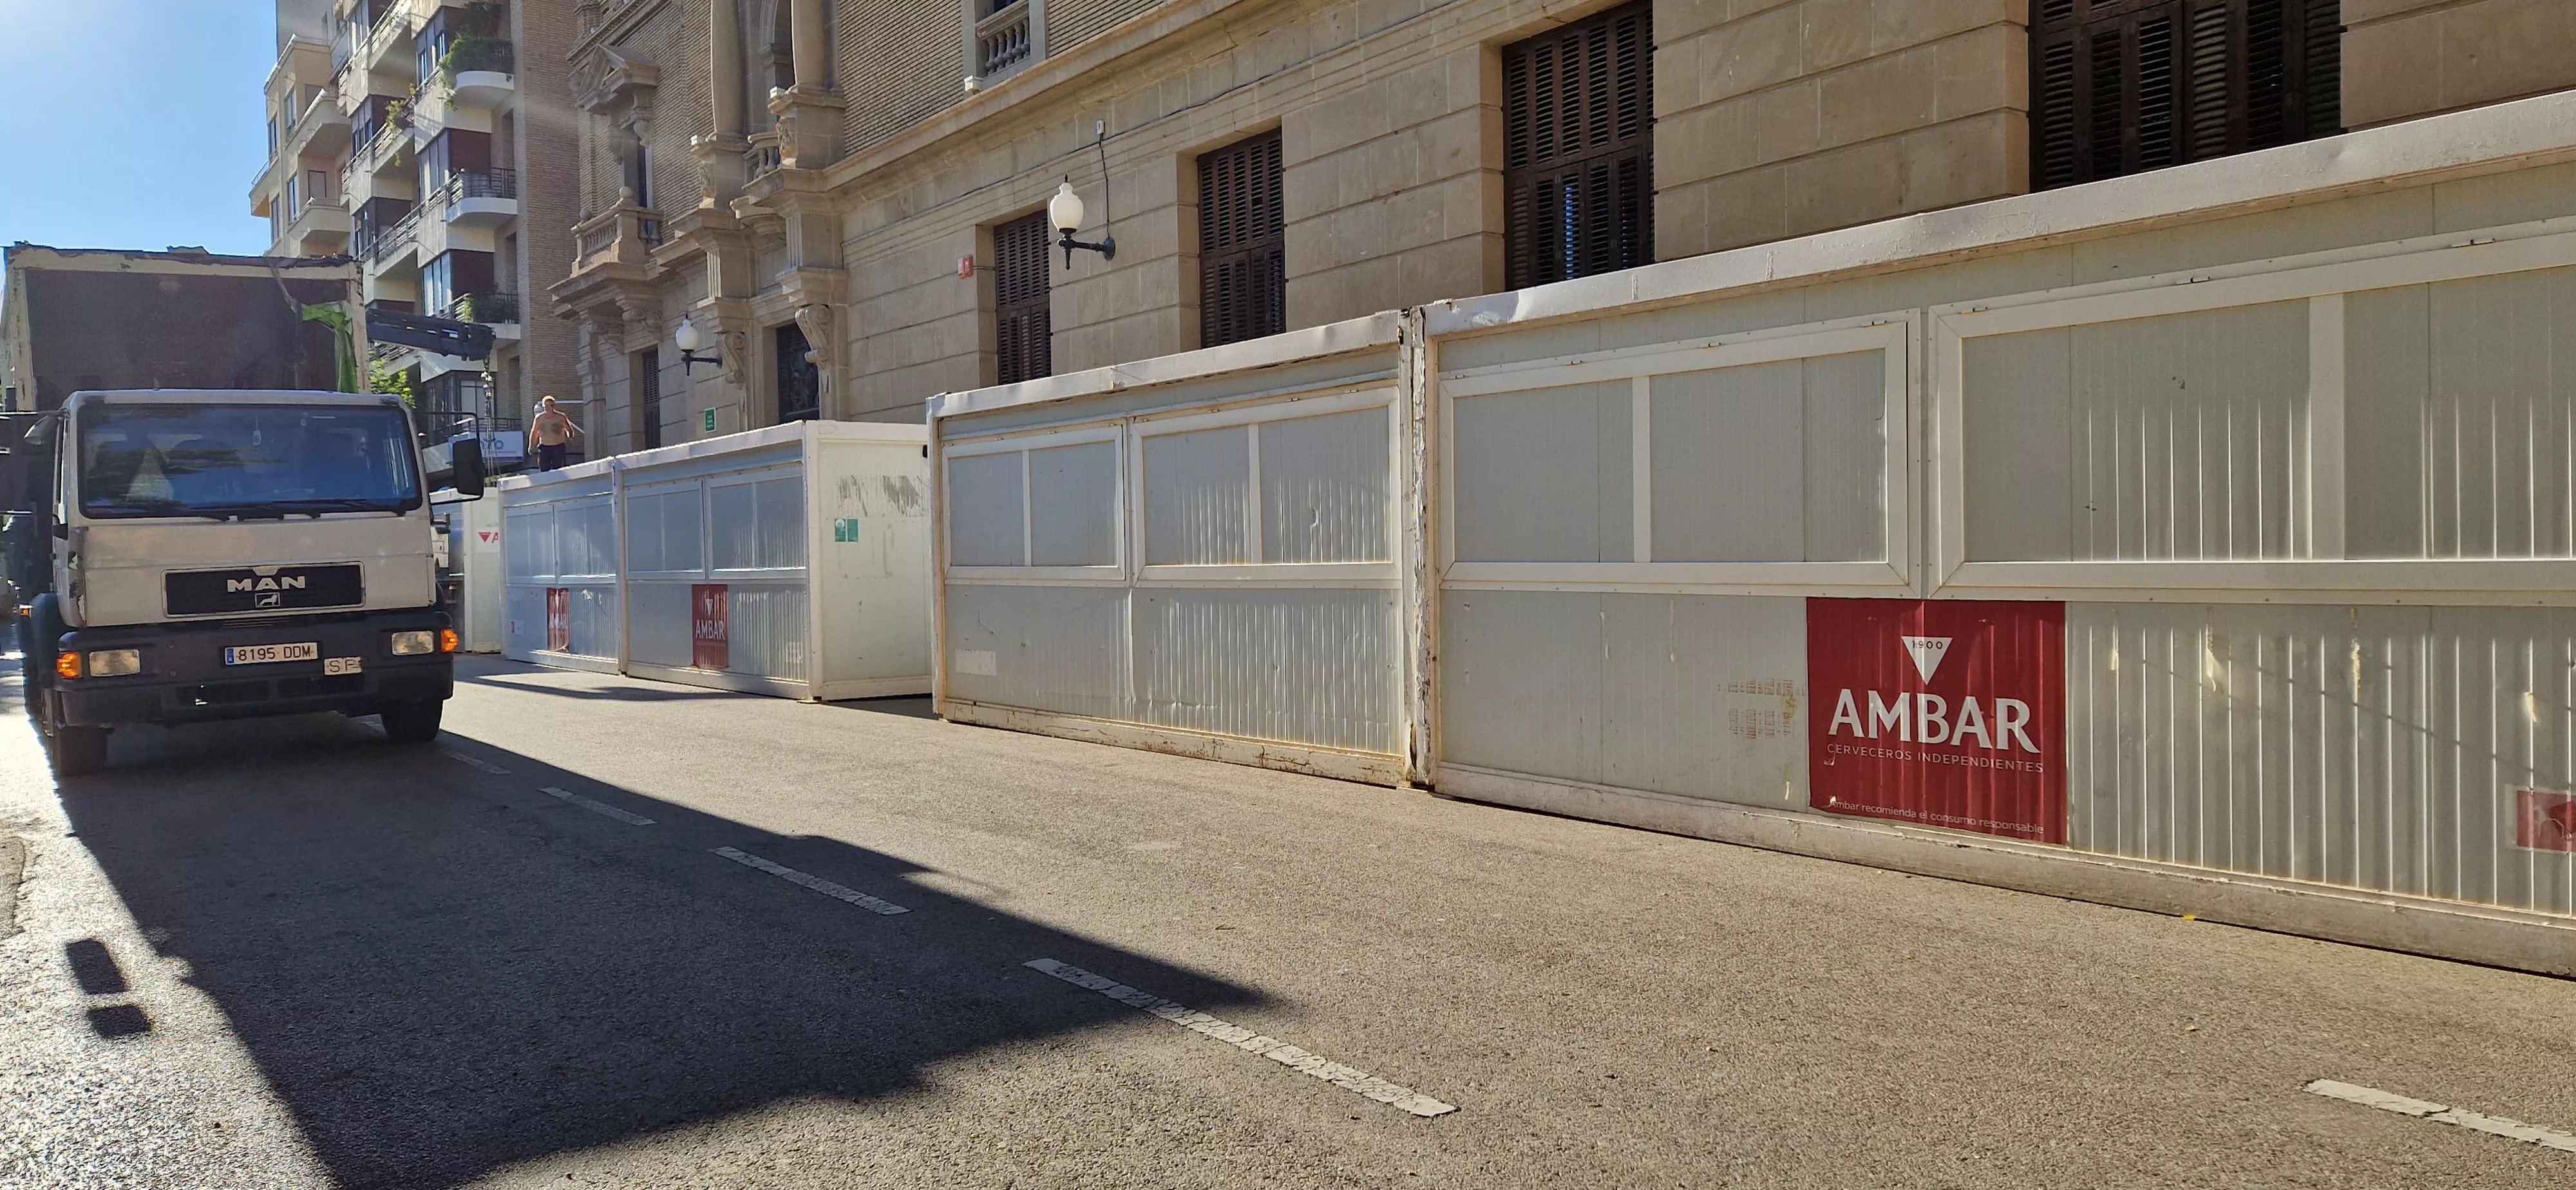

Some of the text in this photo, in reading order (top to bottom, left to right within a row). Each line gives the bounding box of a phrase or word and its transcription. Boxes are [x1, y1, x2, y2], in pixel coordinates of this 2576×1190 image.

[227, 576, 306, 592] MAN
[696, 619, 726, 641] AMBAR
[238, 645, 310, 661] 8195 DDM
[1912, 640, 1943, 649] 1900
[1828, 688, 2041, 753] AMBAR
[1827, 743, 2043, 773] CERVECEROS INDEPENDIENTES
[1830, 800, 2043, 834] Ambar recomienda el consumo responsable
